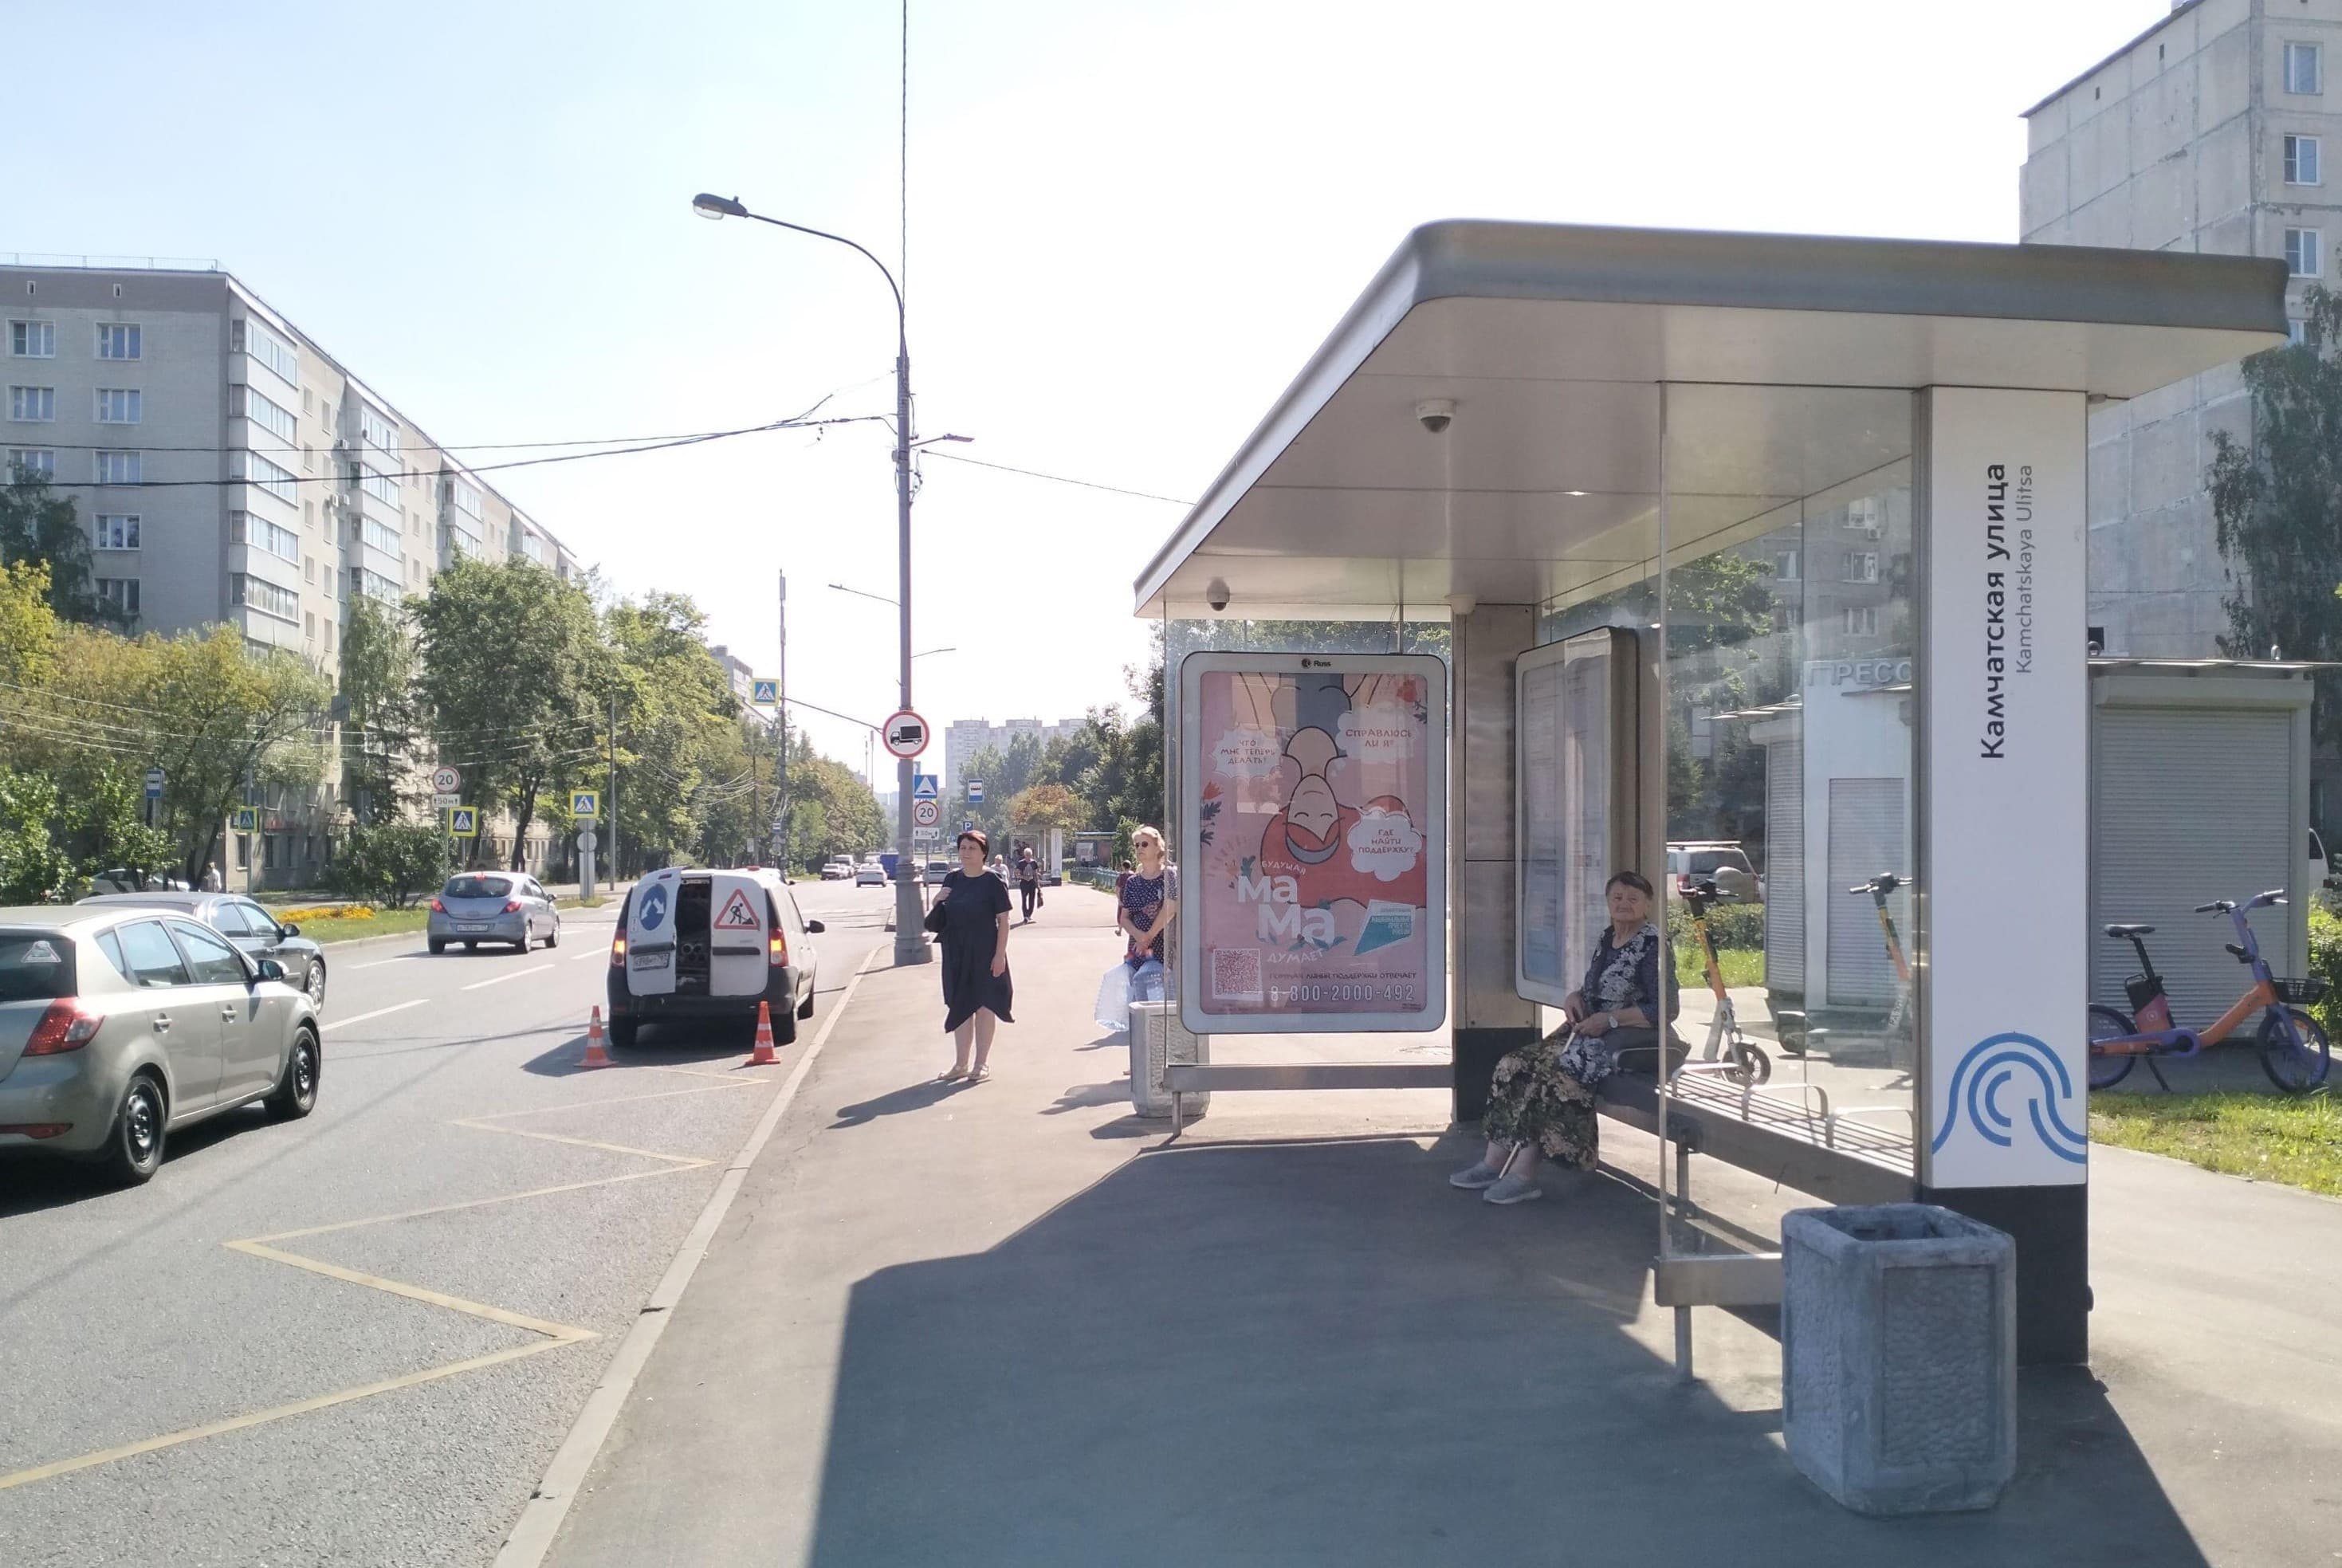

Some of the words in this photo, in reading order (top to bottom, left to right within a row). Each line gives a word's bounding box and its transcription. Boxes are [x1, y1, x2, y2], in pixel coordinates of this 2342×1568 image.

[2015, 465, 2033, 521] Ulitsa
[1987, 463, 2010, 560] улица
[2015, 529, 2036, 674] Kamchatskaya
[1981, 572, 2004, 759] Камчатская
[1345, 729, 1412, 738] СПРАВЛЮСЬ
[1365, 738, 1379, 747] ЛИ
[438, 775, 453, 784] 20
[920, 808, 933, 817] 20
[1267, 948, 1324, 964] ДУМАЕТ
